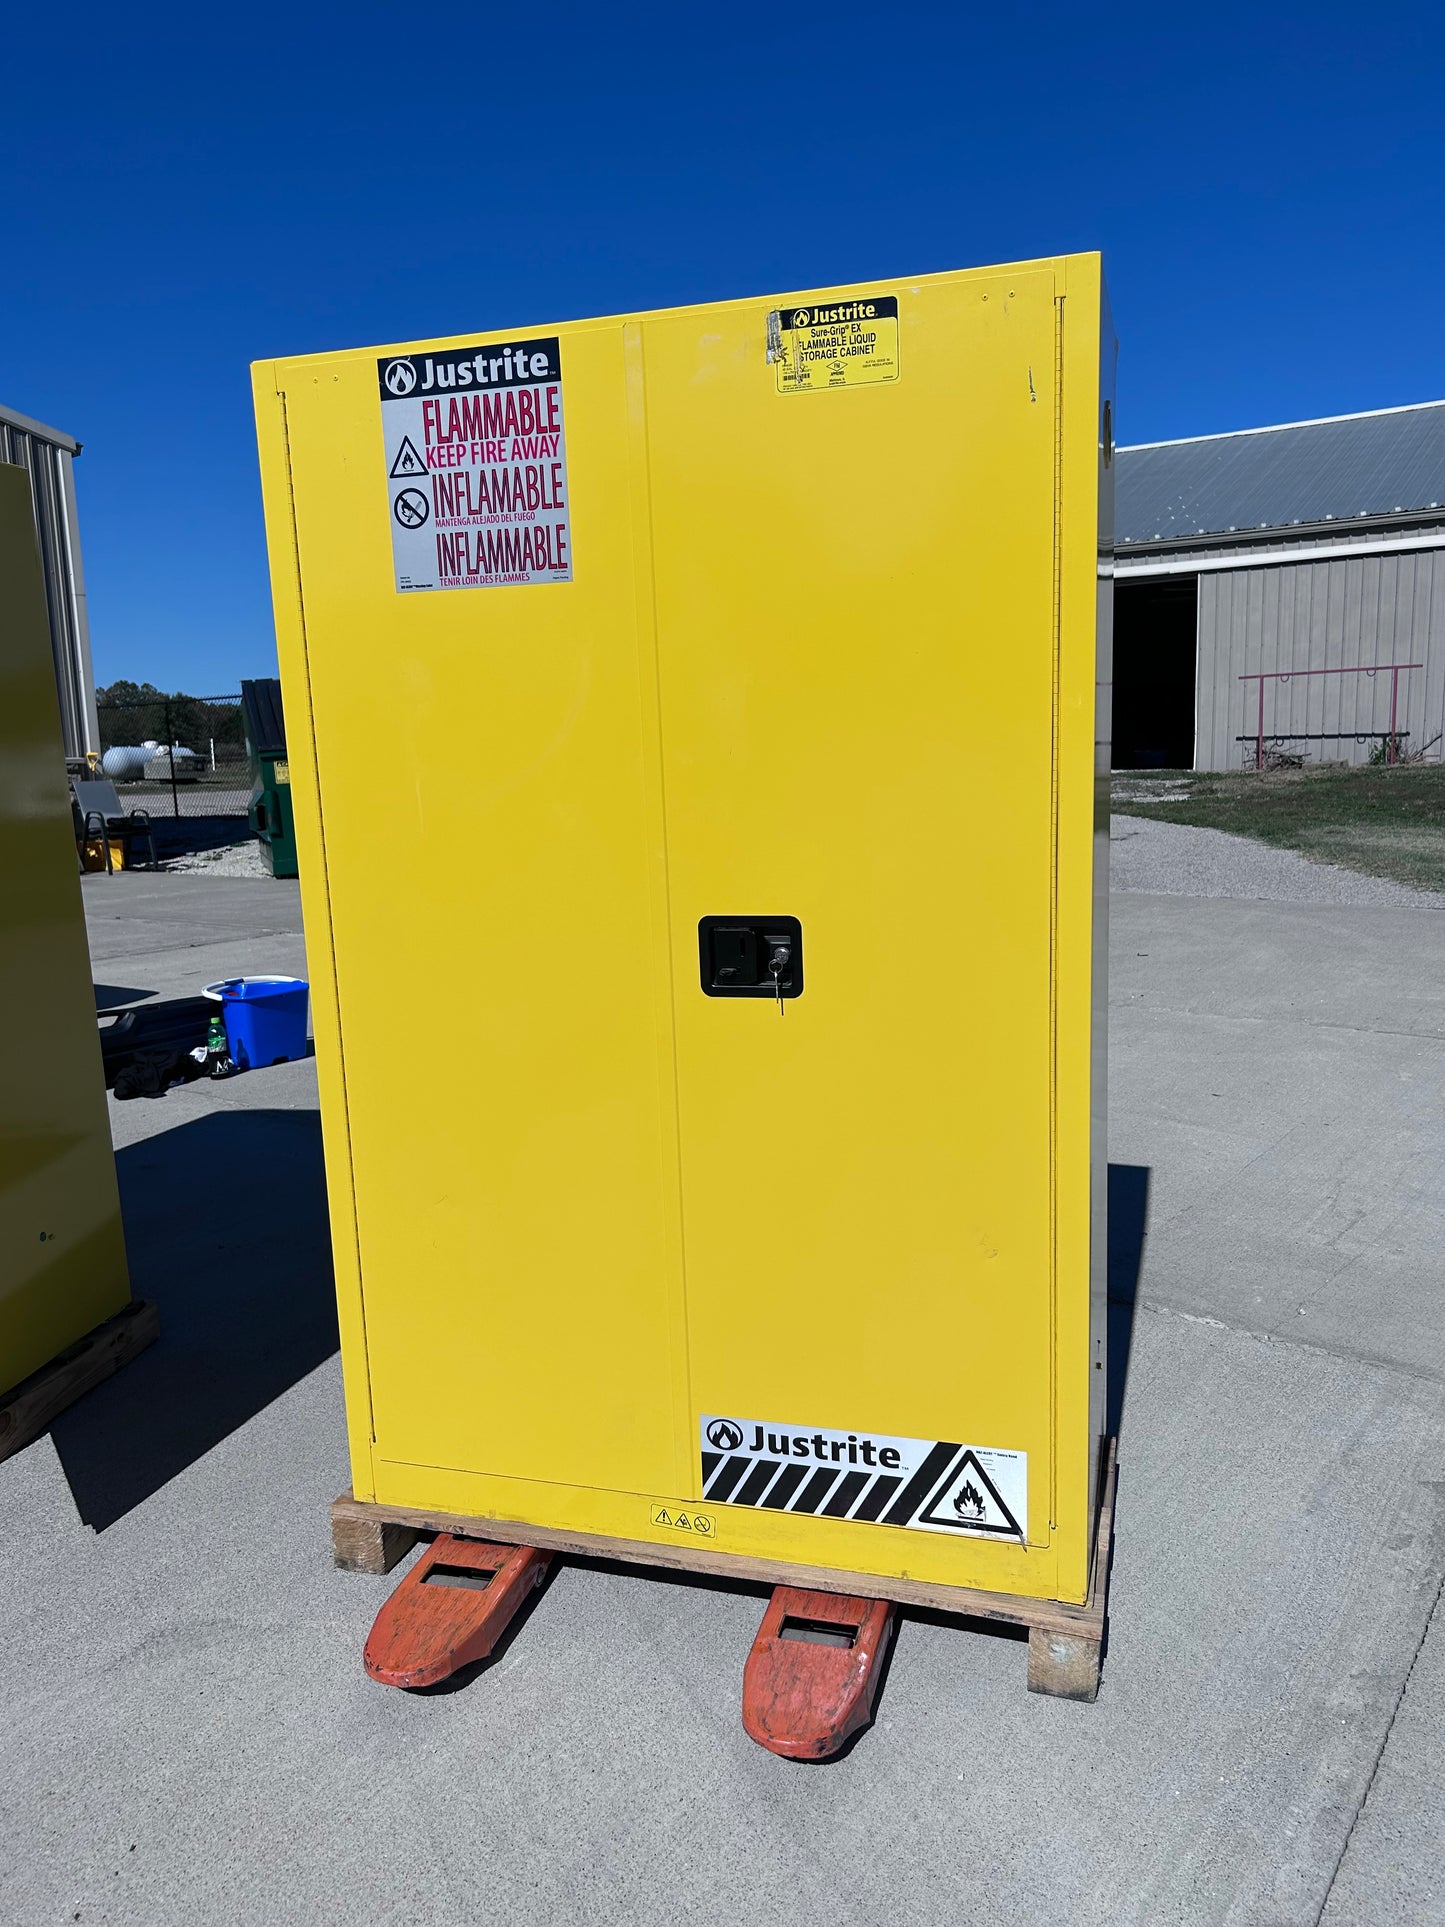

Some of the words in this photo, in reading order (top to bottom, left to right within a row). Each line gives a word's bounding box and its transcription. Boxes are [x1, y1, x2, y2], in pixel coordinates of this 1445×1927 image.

[851, 323, 862, 333] EX
[849, 332, 877, 345] LIQUID
[839, 343, 876, 358] CABINET
[422, 386, 561, 445] FLAMMABLE
[425, 442, 467, 469] KEEP
[471, 439, 508, 465] FIRE
[511, 434, 560, 462] AWAY
[431, 462, 565, 519] INFLAMABLE
[435, 515, 471, 528] MANTENGA
[471, 513, 500, 526] ALEJADO
[501, 512, 514, 523] DEL
[514, 511, 536, 522] FUEGO
[436, 523, 568, 577] INFLAMMABLE
[439, 575, 461, 587] TENIR
[461, 574, 479, 585] LOIN
[479, 574, 493, 584] DES
[494, 572, 531, 583] FLAMMES
